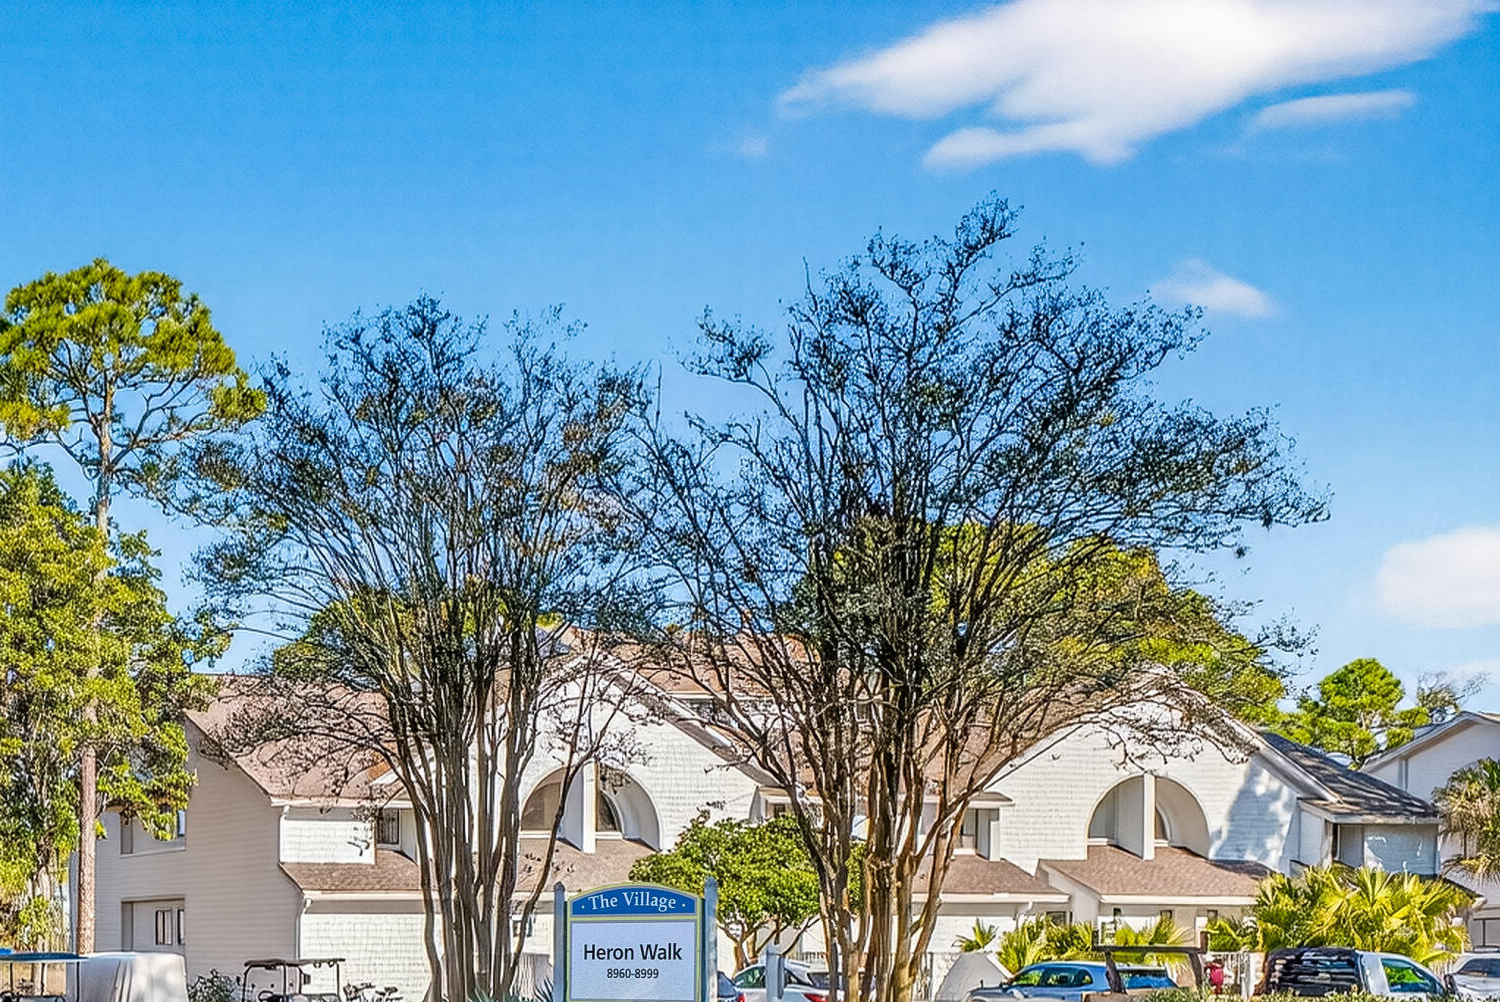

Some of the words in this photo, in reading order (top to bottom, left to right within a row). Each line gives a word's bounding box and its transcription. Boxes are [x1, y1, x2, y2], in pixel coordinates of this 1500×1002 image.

[588, 894, 618, 910] The
[622, 891, 677, 912] Village
[583, 944, 634, 960] Heron
[640, 943, 682, 960] Walk
[607, 968, 659, 978] 8960-8999
